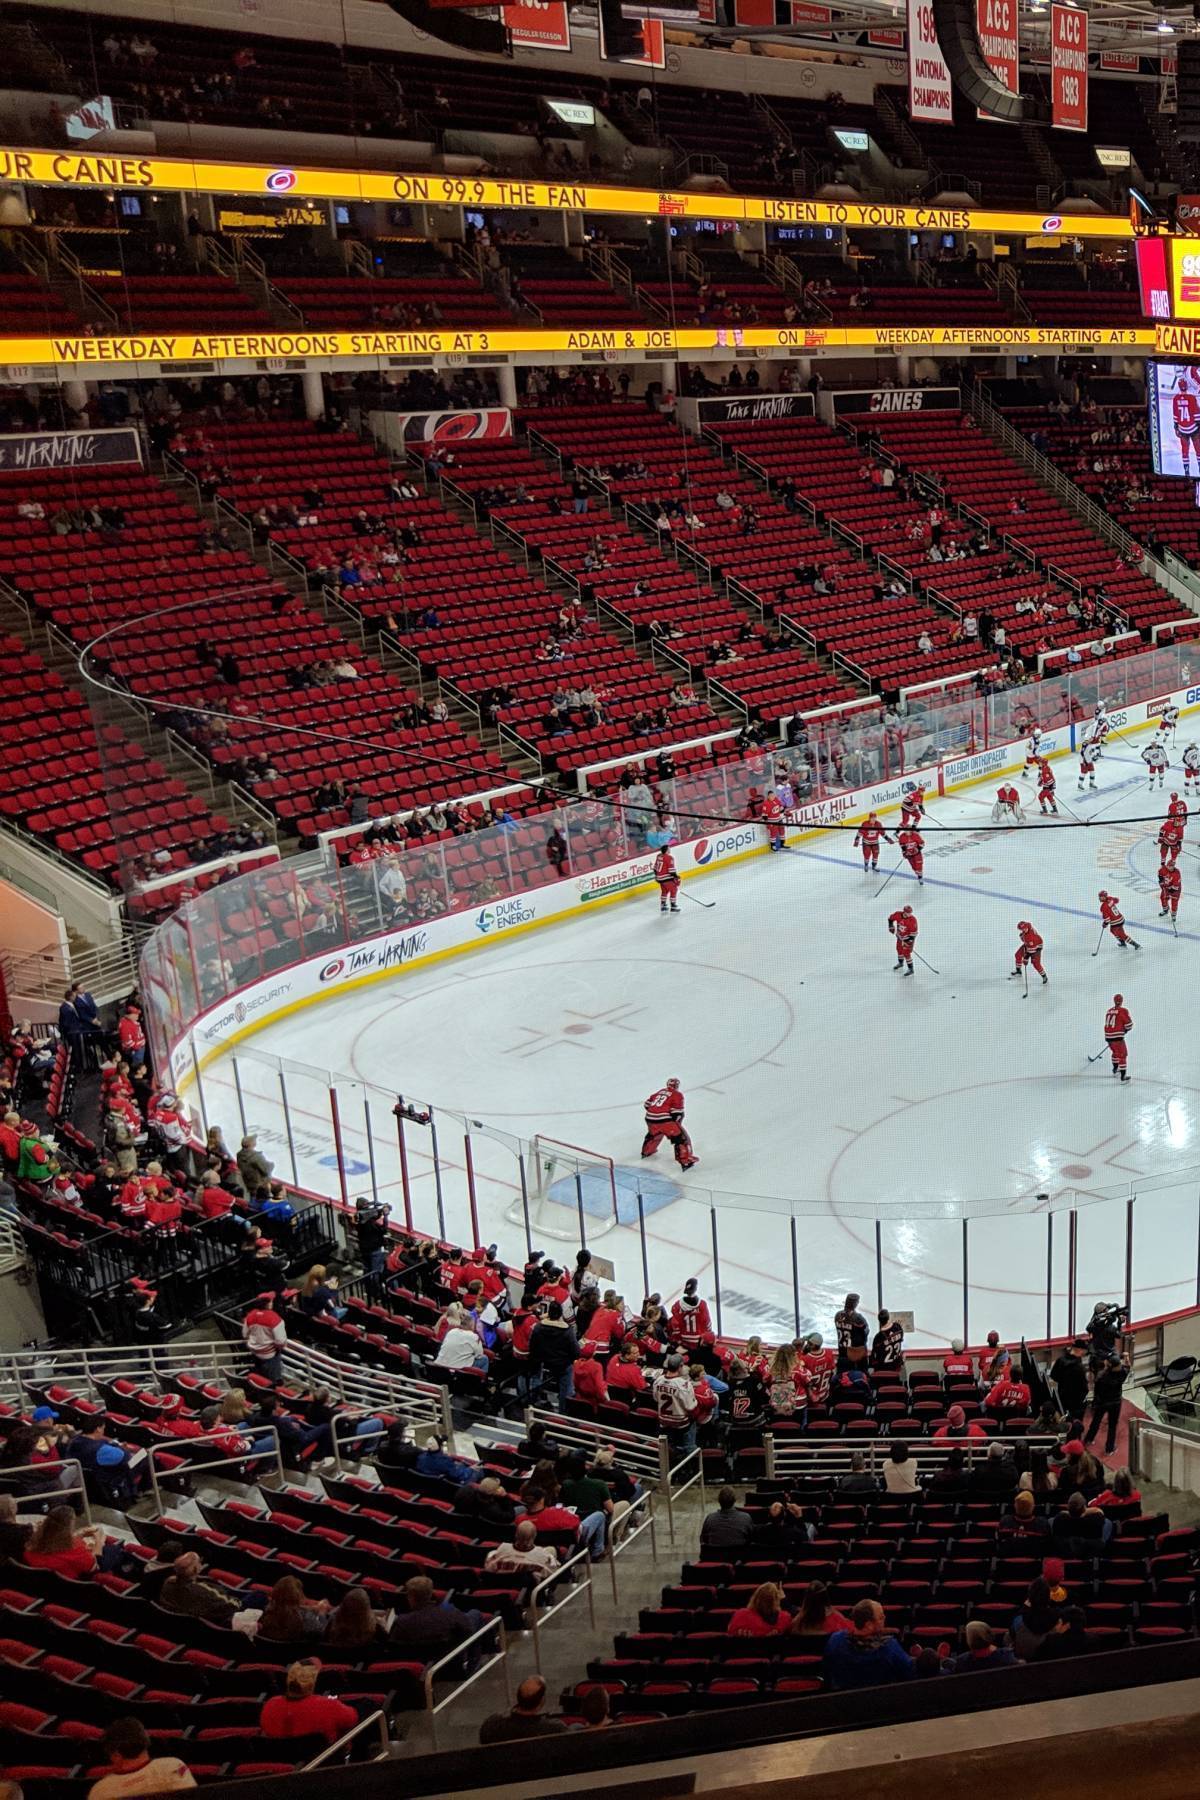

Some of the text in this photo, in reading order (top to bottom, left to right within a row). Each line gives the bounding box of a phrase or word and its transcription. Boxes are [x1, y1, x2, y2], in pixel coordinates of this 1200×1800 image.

[917, 5, 937, 44] 198
[986, 0, 1009, 31] ACC
[1060, 14, 1080, 44] ACC
[980, 33, 1016, 61] CHAMPIONS
[1054, 47, 1086, 73] CHAMPIONS
[915, 59, 947, 81] NATIONAL
[913, 87, 950, 110] CHAMPIONS
[1062, 75, 1079, 106] 1983
[53, 155, 154, 186] CANES
[394, 175, 428, 200] ON
[442, 178, 484, 202] 99.9
[497, 184, 534, 204] THE
[548, 186, 586, 208] FAN
[764, 200, 970, 229] LISTEN TO YOUR CANES
[55, 330, 798, 361] WEEKDAY AFTERNOONS STARTING AT 3 ADAM & JOE ON
[876, 330, 1136, 344] WEEKDAY AFTERNOONS STARTING AT 3
[726, 398, 793, 424] TAKE WARNING
[870, 392, 922, 412] CANES
[1178, 406, 1190, 422] 74
[16, 436, 100, 469] WARNING
[945, 748, 1008, 777] RALEIGH ORTHOPAEDIC
[872, 778, 932, 806] Michael Son
[789, 796, 857, 826] BULLY HILL
[716, 828, 756, 857] pepsi
[590, 868, 628, 890] Harris
[630, 862, 654, 878] Teet
[496, 900, 522, 916] DUKE
[497, 907, 536, 929] ENERGY
[347, 930, 430, 972] TAKE WARNING
[204, 1013, 234, 1039] VECTOR
[660, 1394, 674, 1414] 2
